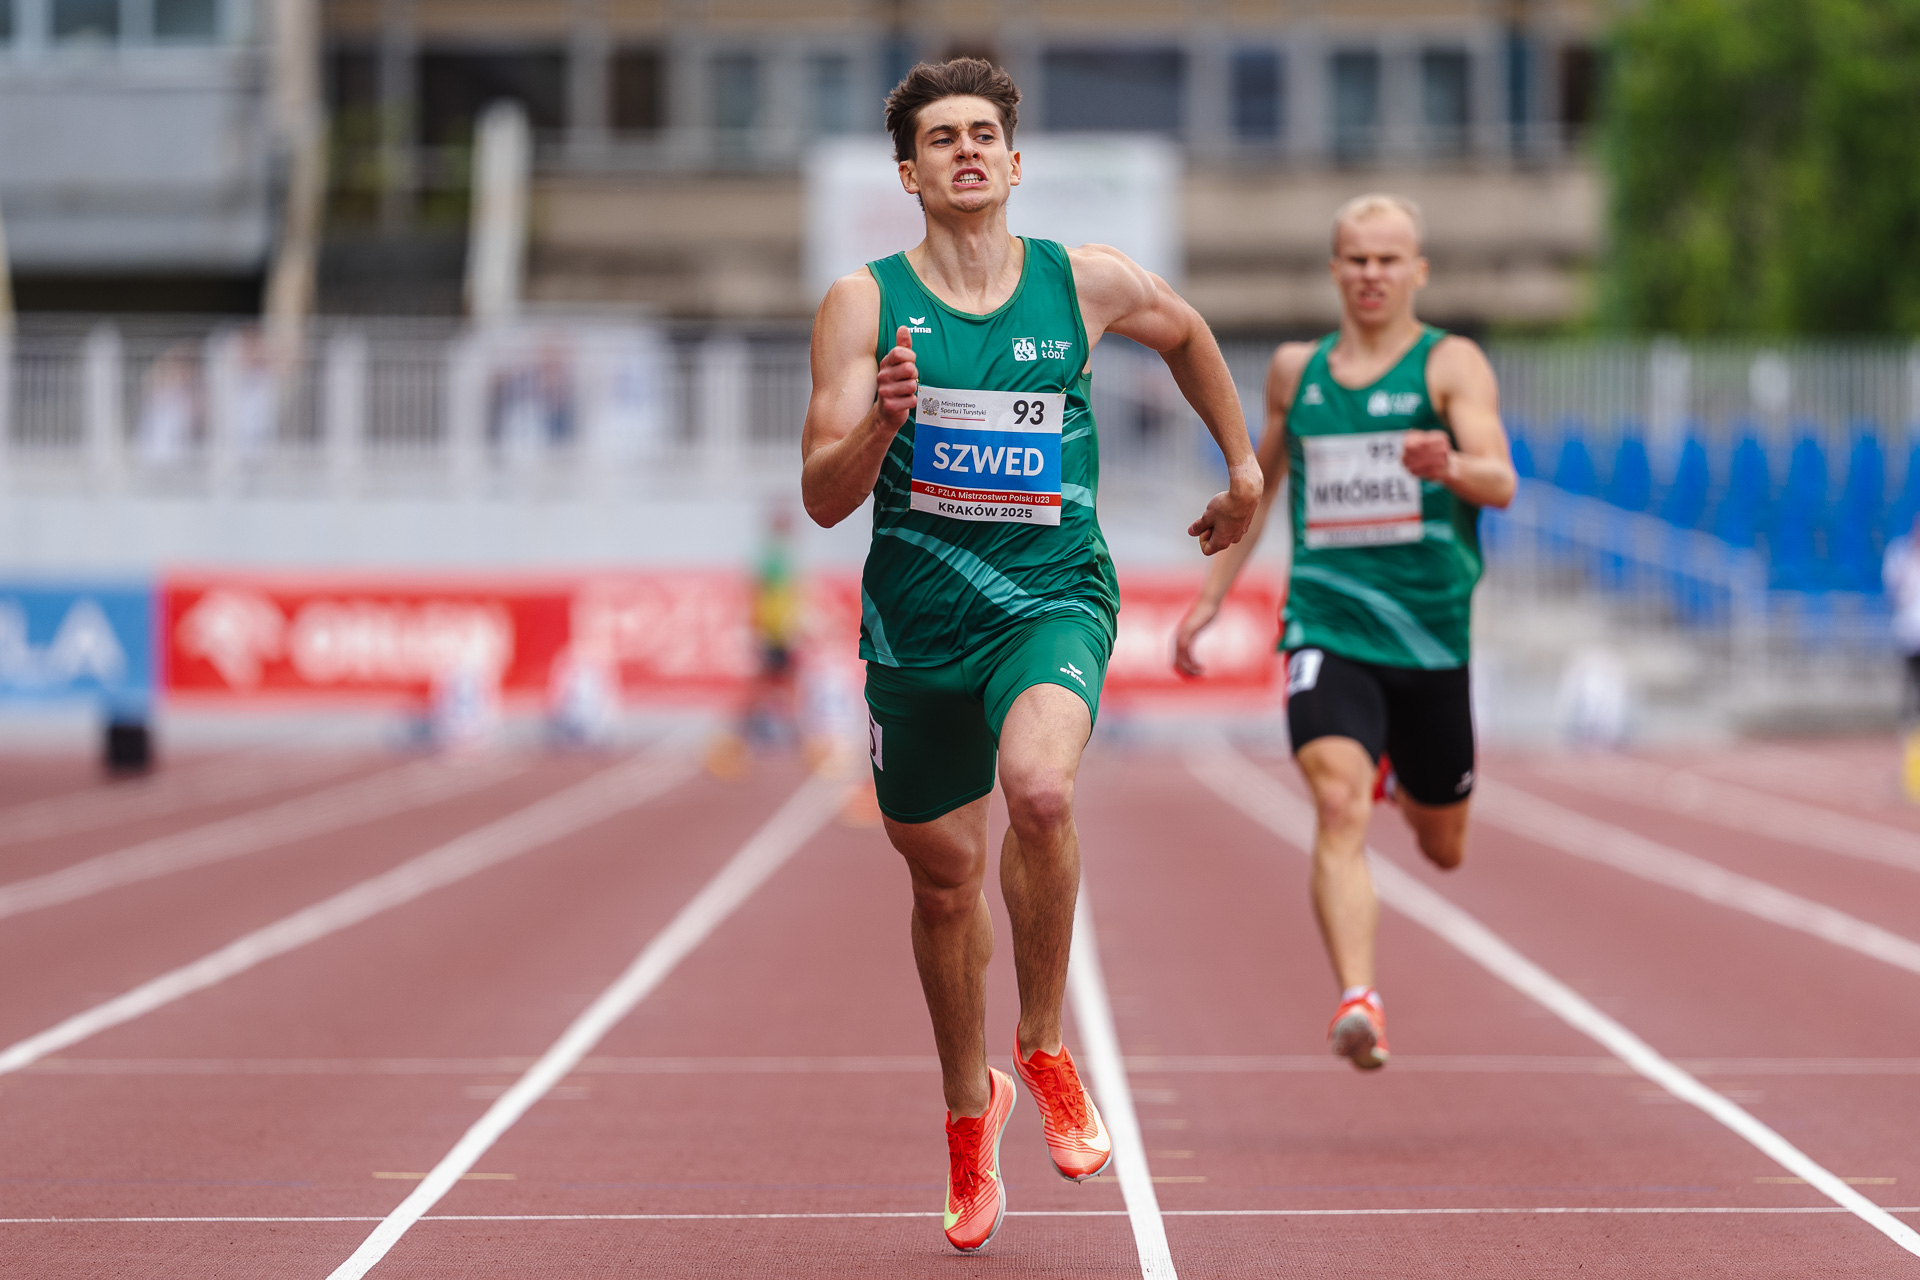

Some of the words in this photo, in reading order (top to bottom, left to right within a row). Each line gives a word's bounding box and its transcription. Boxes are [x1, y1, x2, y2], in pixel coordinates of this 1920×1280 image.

[940, 400, 976, 409] Ministerstwo
[940, 407, 959, 416] Sportu
[962, 408, 987, 418] Turystyki
[1013, 399, 1045, 425] 93
[932, 442, 1044, 476] SZWED
[924, 485, 936, 494] 42.
[937, 489, 956, 498] PZLA
[958, 491, 1008, 501] Mistrzostwa
[1009, 494, 1033, 503] Polski
[1034, 496, 1050, 504] U23
[938, 502, 998, 517] KRAKÓW
[1001, 507, 1033, 518] 2025
[1059, 667, 1087, 688] erima
